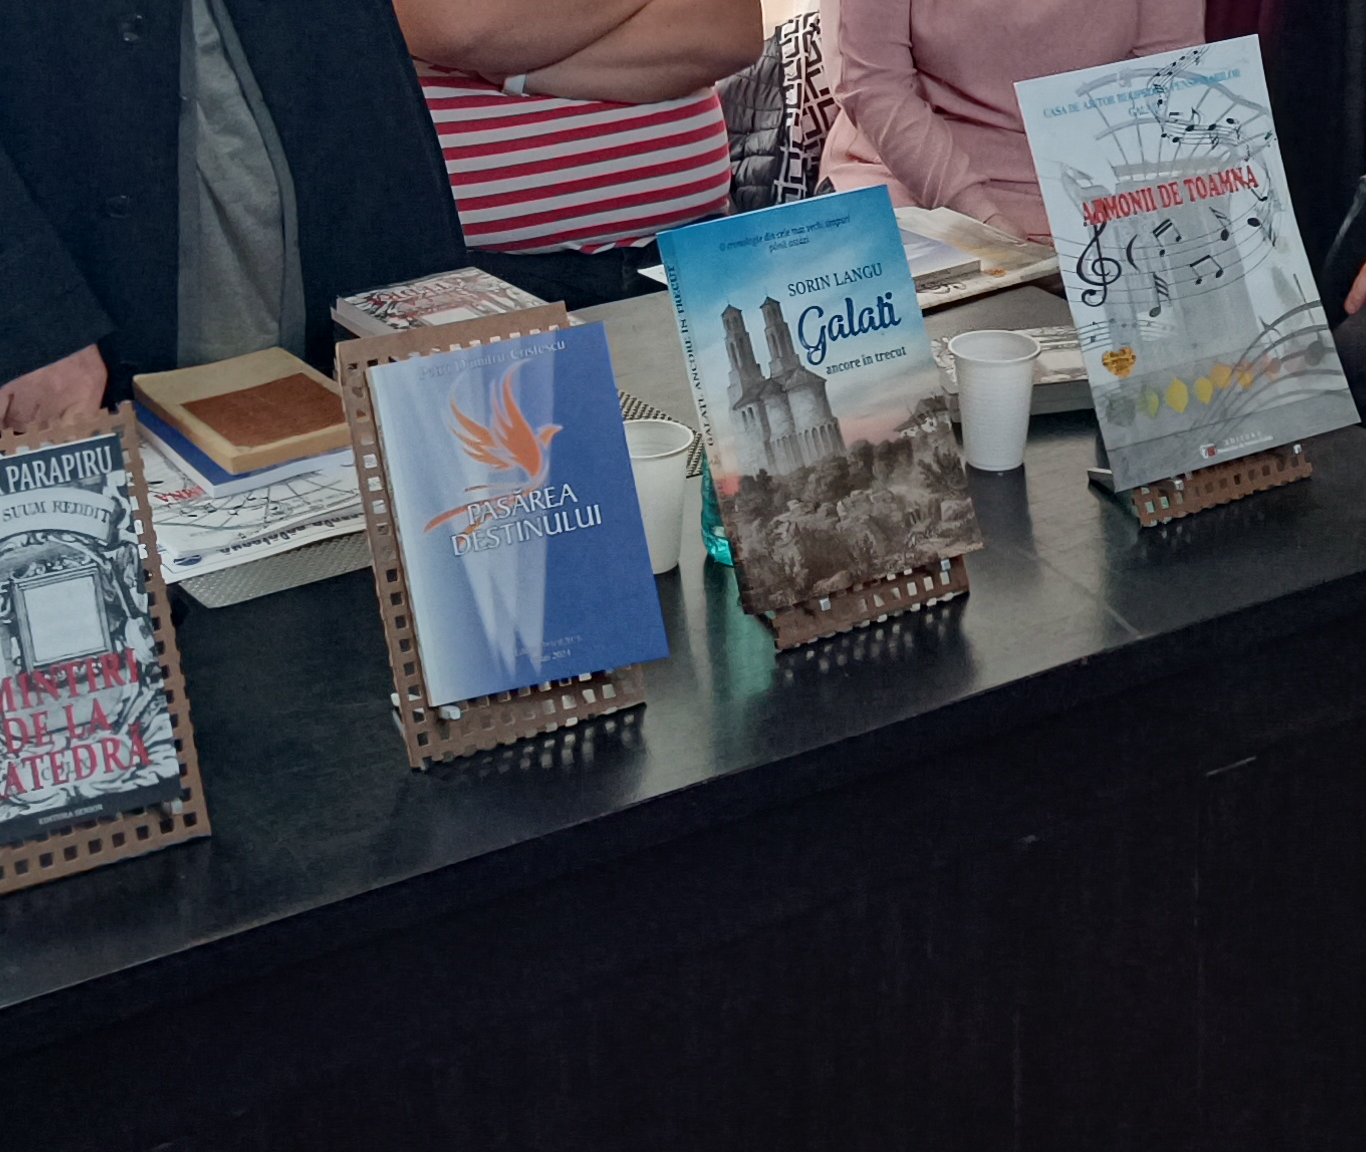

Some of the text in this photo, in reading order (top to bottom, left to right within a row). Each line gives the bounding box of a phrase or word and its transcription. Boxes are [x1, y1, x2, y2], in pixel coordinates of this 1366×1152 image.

[1082, 187, 1157, 226] ARMONII
[1157, 181, 1183, 208] DE
[787, 262, 883, 297] SORIN LANGU
[510, 341, 565, 360] Cristescu
[826, 358, 861, 375] ancore
[875, 346, 907, 362] trecut
[6, 446, 113, 493] PARAPIRU
[2, 501, 46, 522] SUUM
[52, 501, 110, 524] REDDIT
[467, 483, 578, 525] PASĂREA
[451, 504, 602, 556] DESTINULUI
[3, 698, 113, 754] DE LA
